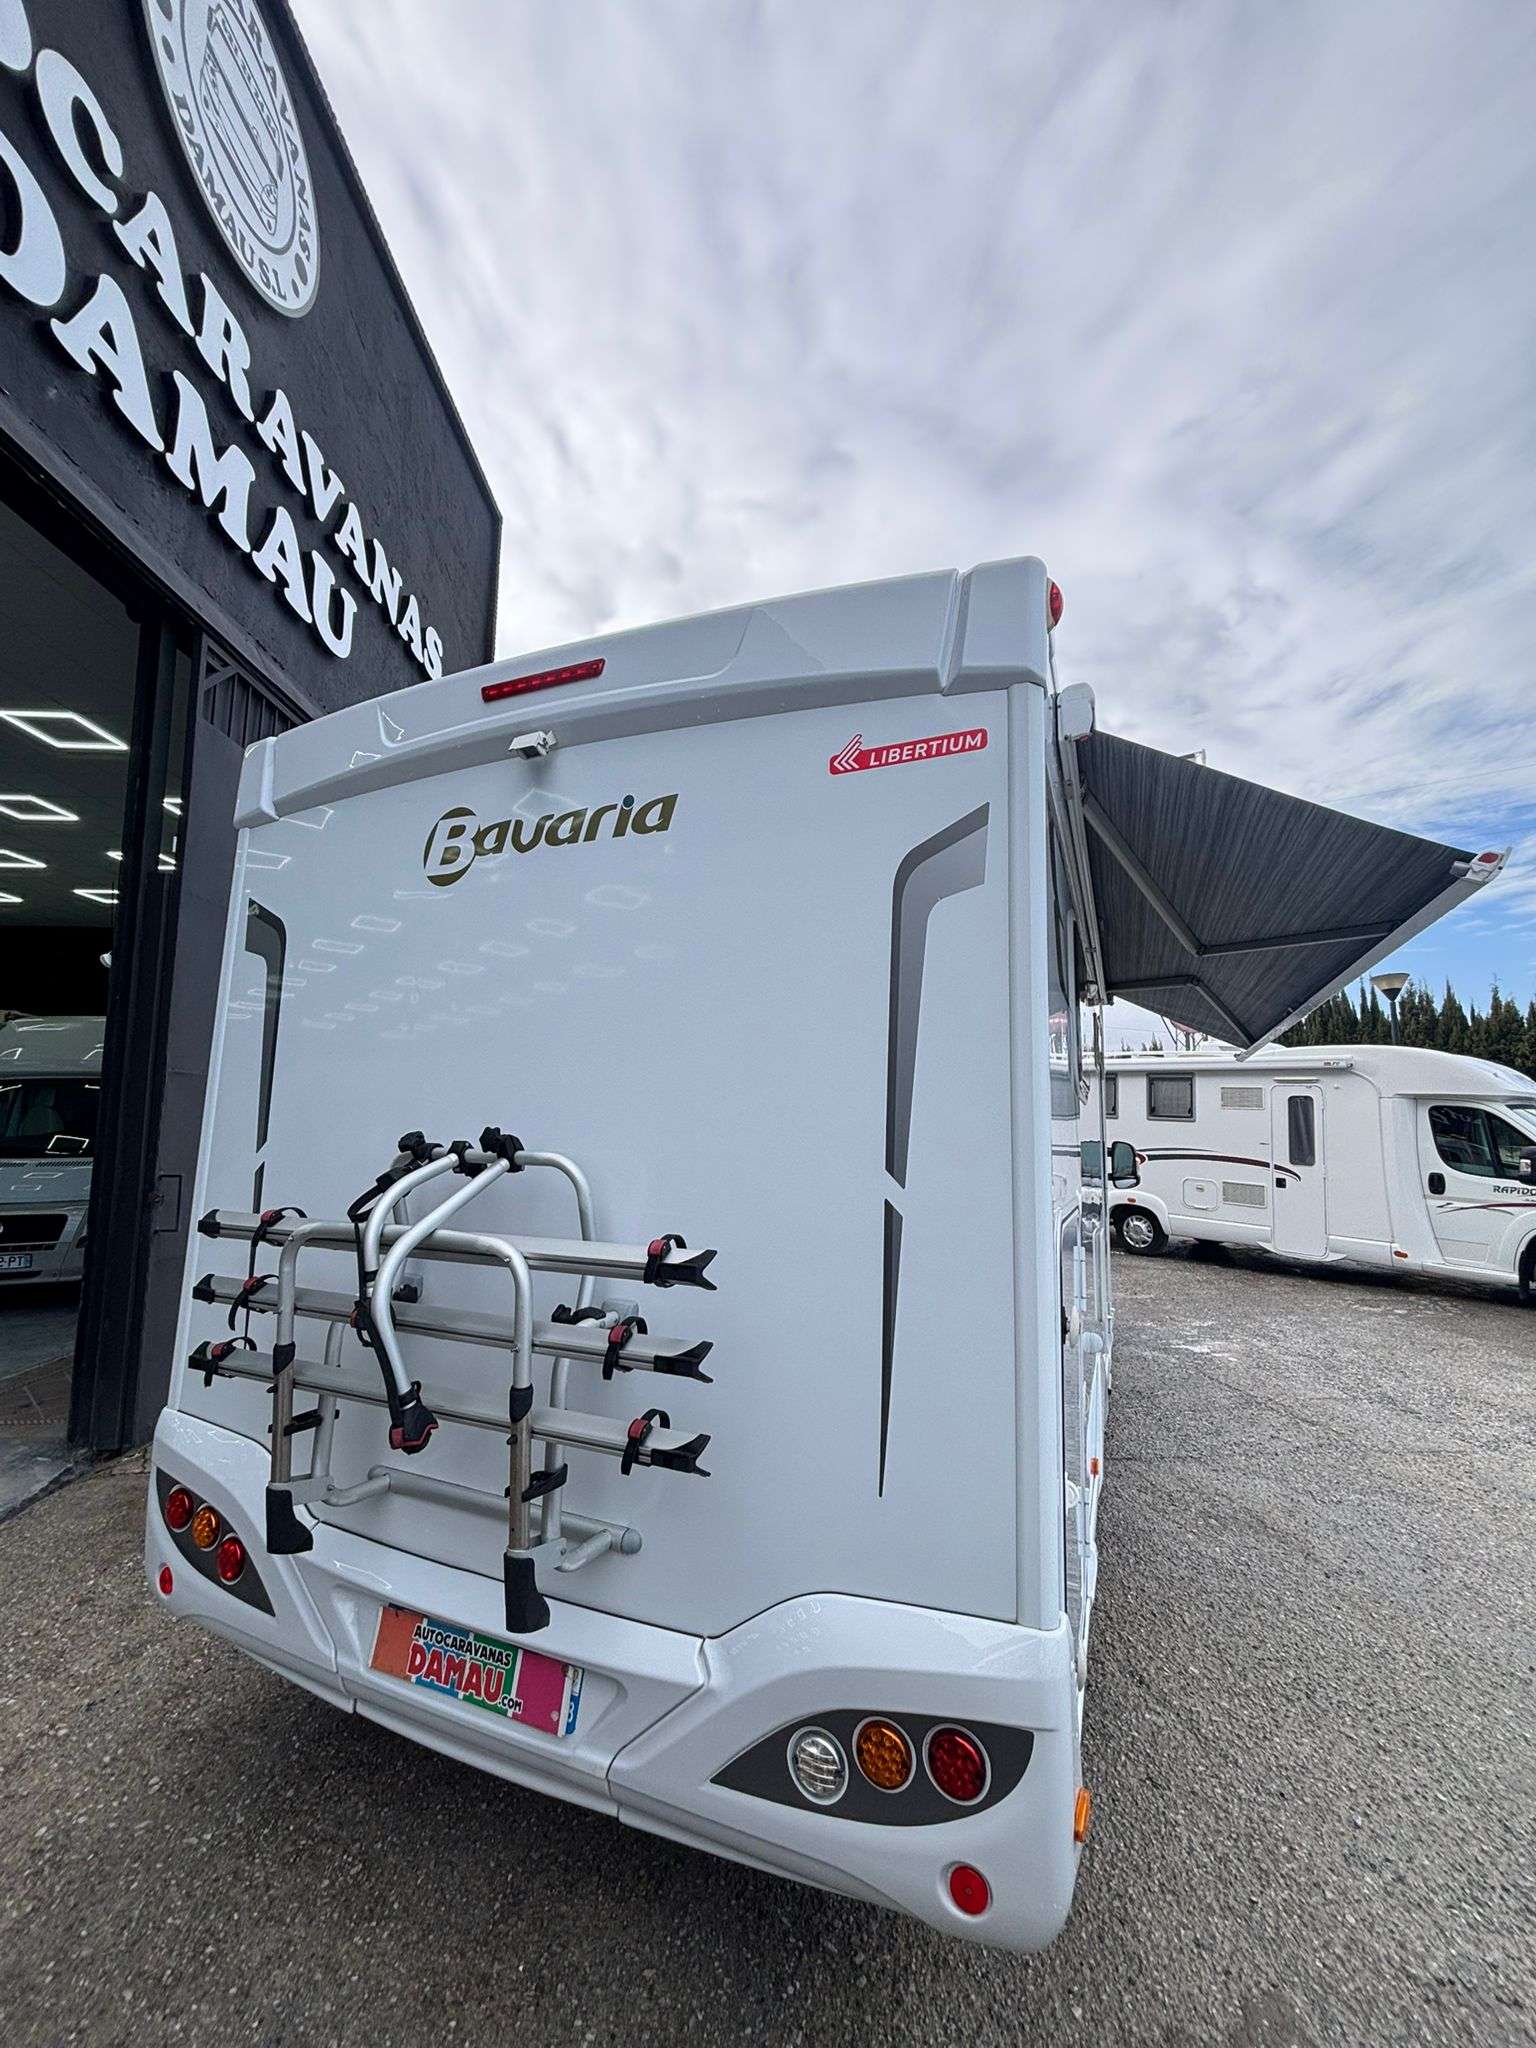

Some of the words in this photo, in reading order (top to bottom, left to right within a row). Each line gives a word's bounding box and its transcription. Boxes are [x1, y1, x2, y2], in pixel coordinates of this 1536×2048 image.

[0, 0, 443, 680] CARAVANAS
[869, 732, 983, 767] LIBERTIUM
[423, 793, 679, 887] Bavaria
[413, 1624, 513, 1668] AUTOCARAVANAS
